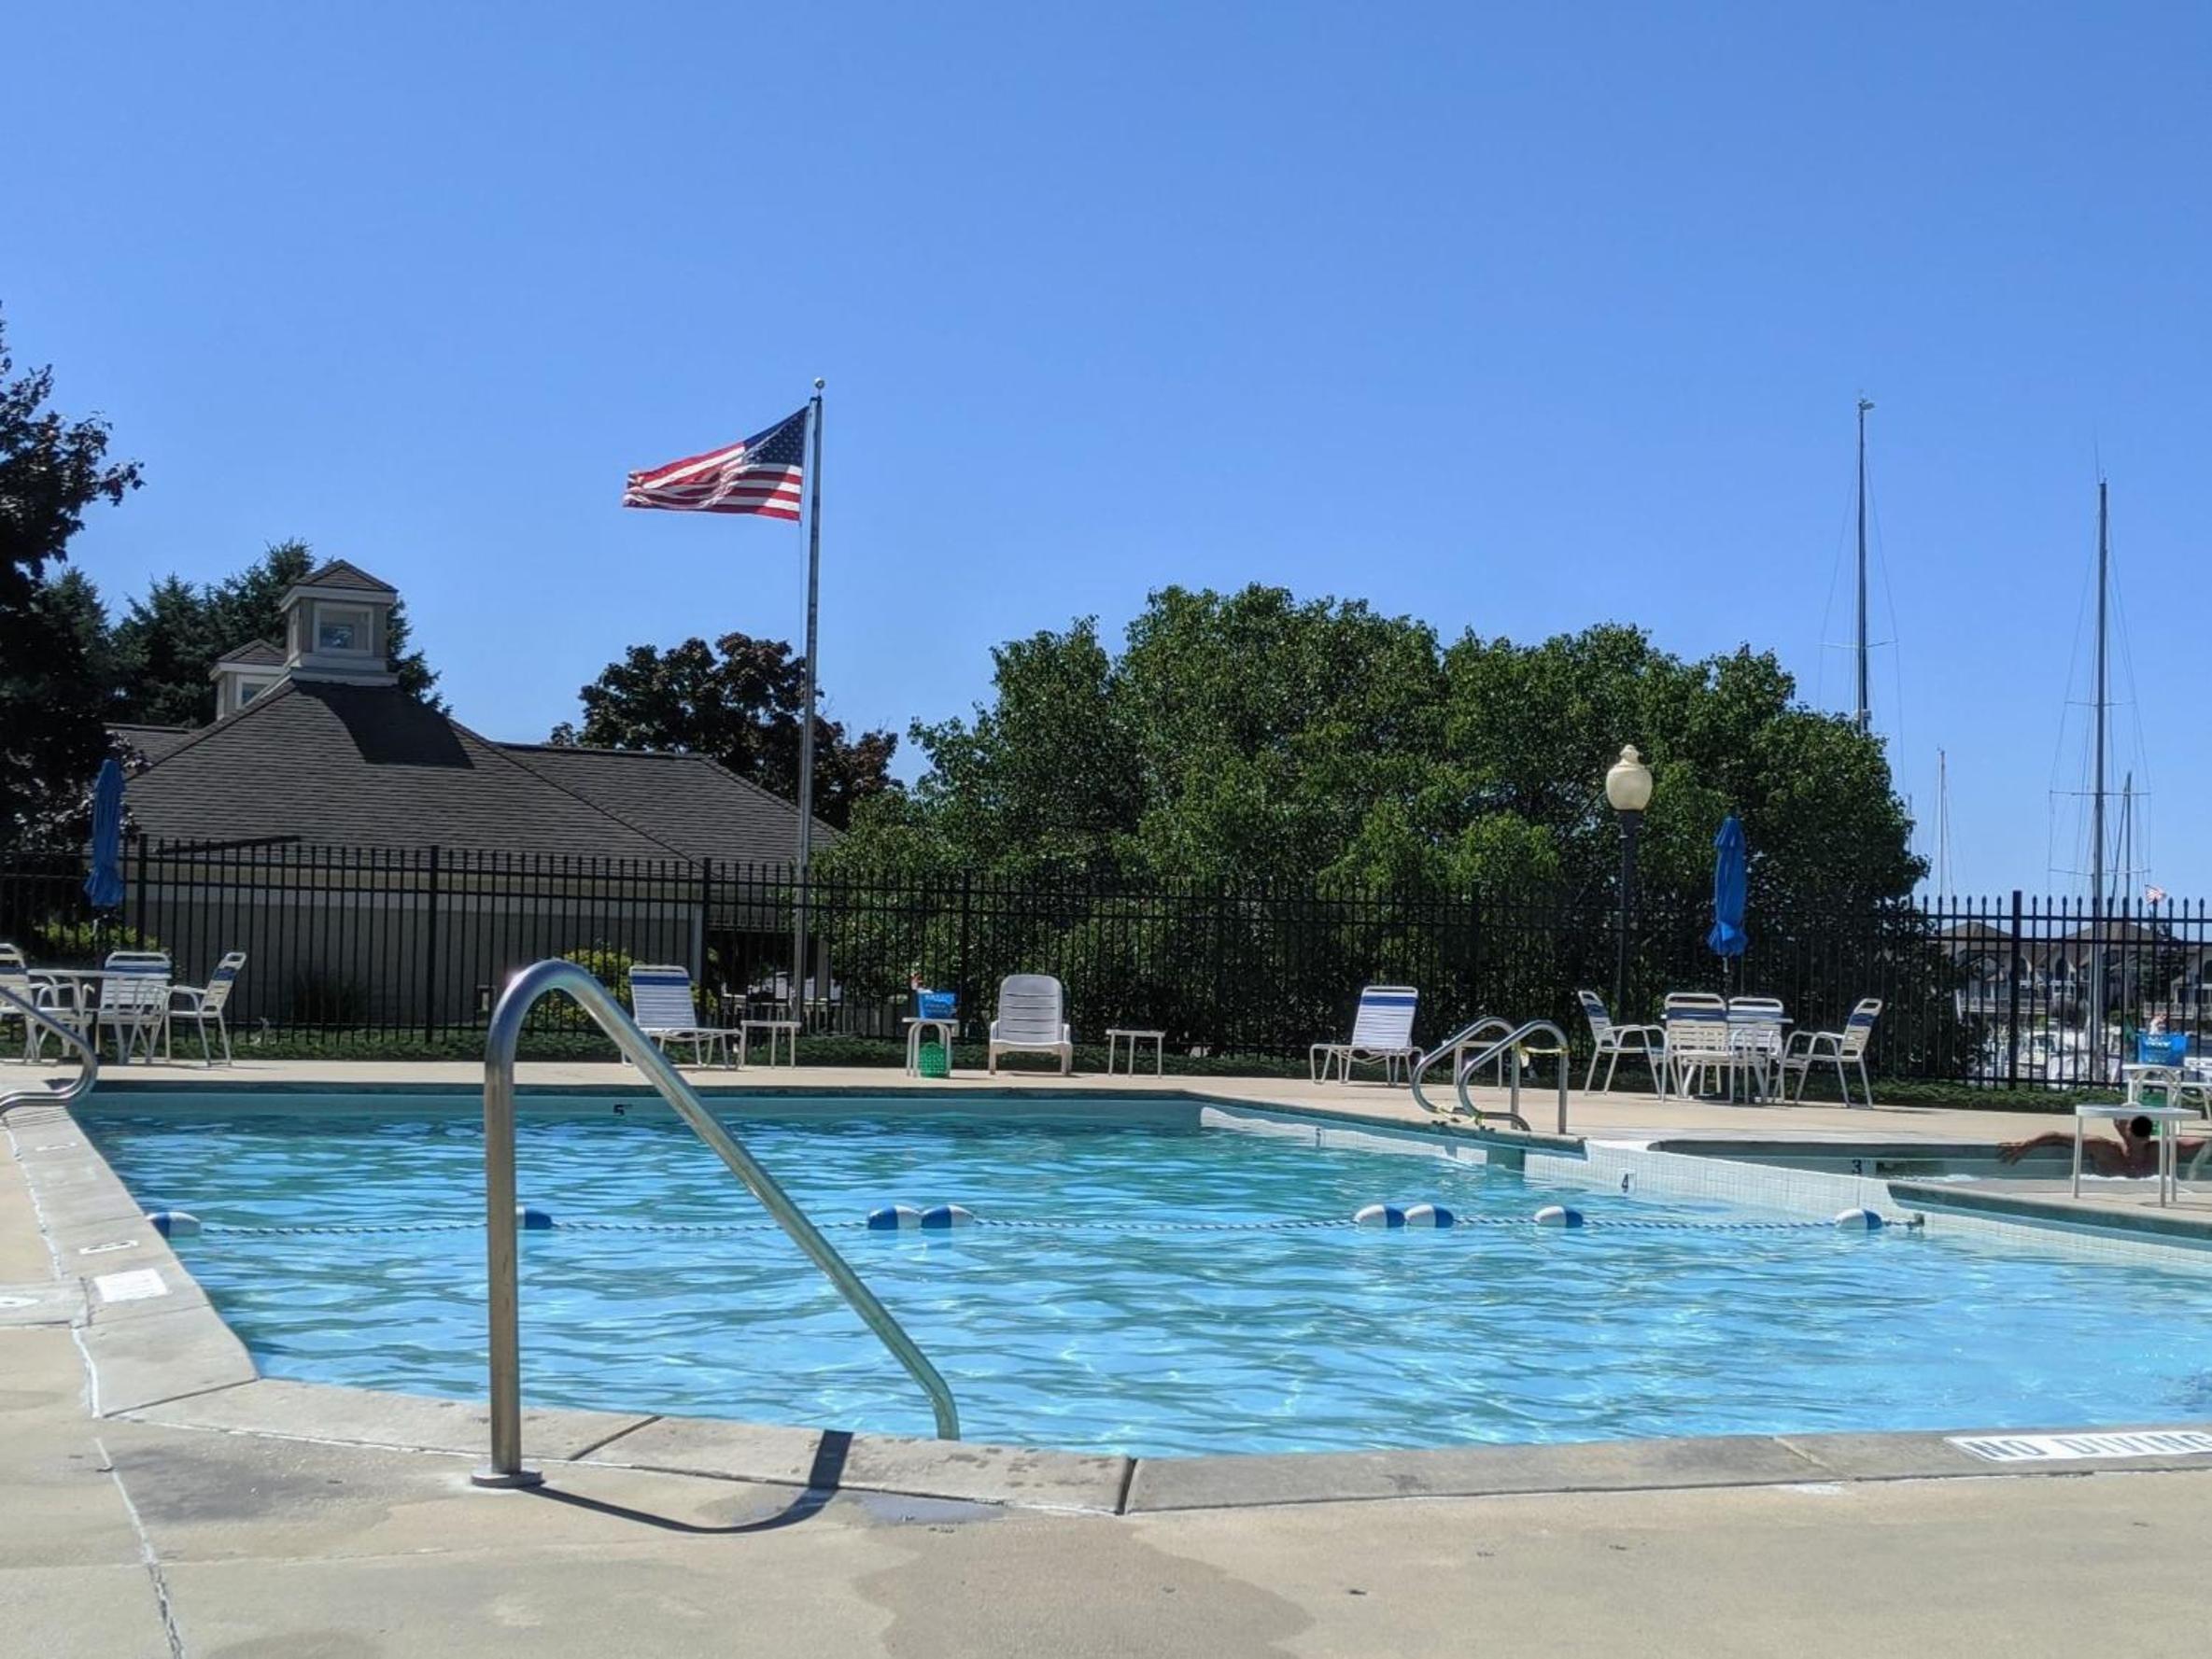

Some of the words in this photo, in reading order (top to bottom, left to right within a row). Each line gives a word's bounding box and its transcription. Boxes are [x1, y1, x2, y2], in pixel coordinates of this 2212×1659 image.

[1852, 1159, 1862, 1174] 3
[1621, 1173, 1629, 1193] 4
[1965, 1440, 2050, 1456] NO
